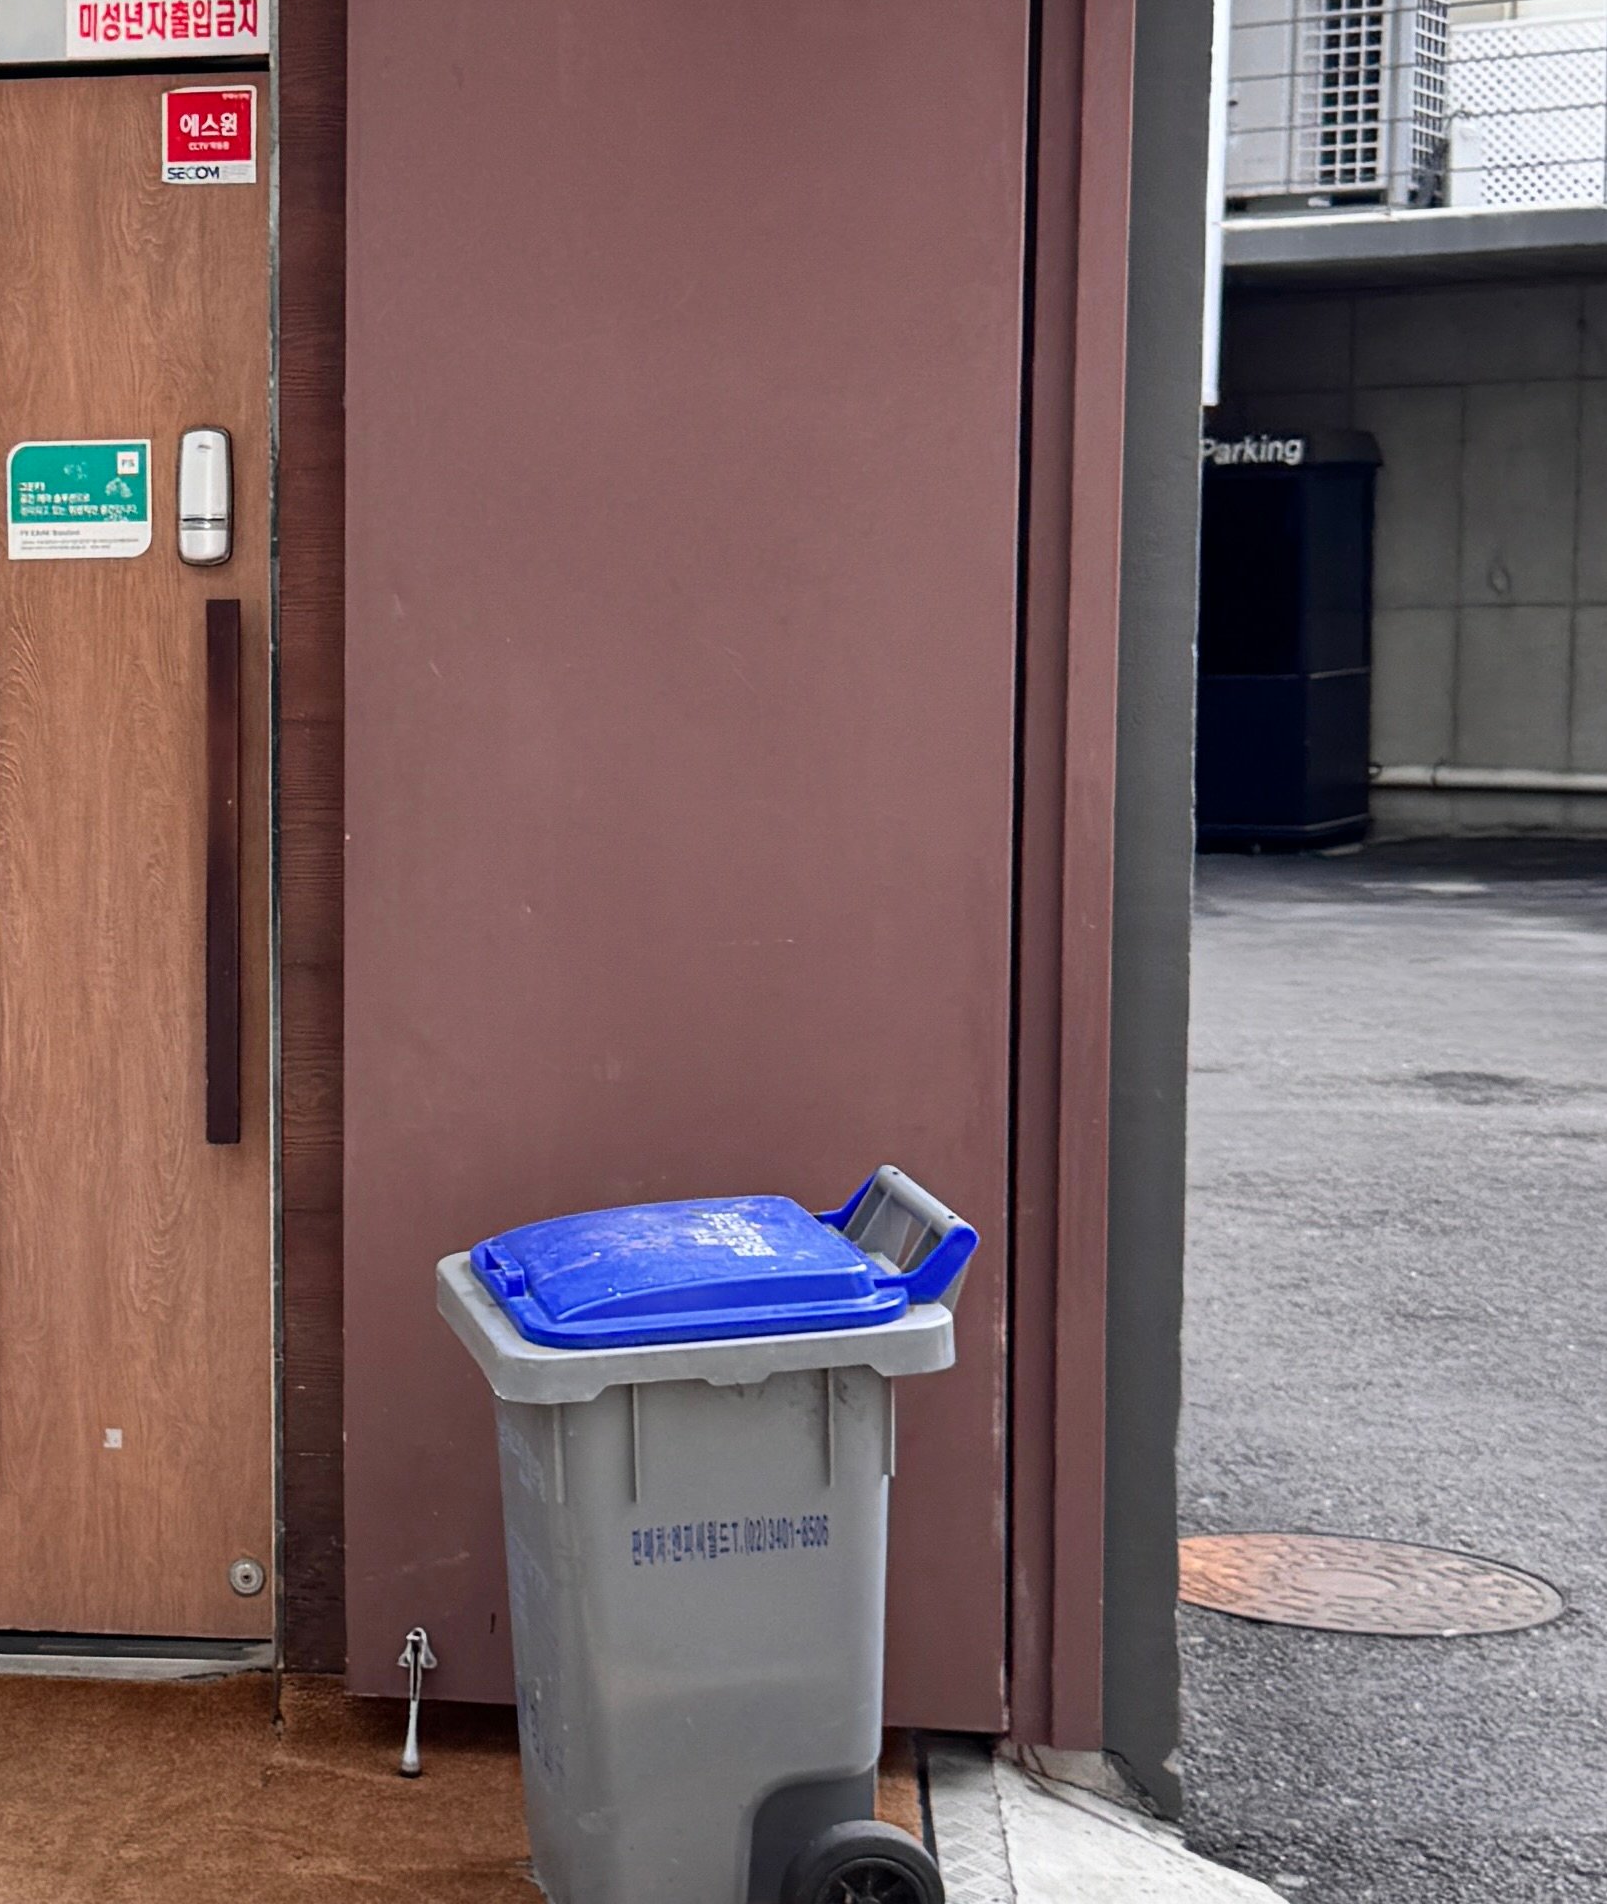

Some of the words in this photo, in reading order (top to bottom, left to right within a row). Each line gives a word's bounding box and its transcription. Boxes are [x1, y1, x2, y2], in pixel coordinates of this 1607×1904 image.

[179, 112, 238, 137] 에스원
[167, 166, 220, 180] SECOM
[1199, 434, 1304, 466] Parking
